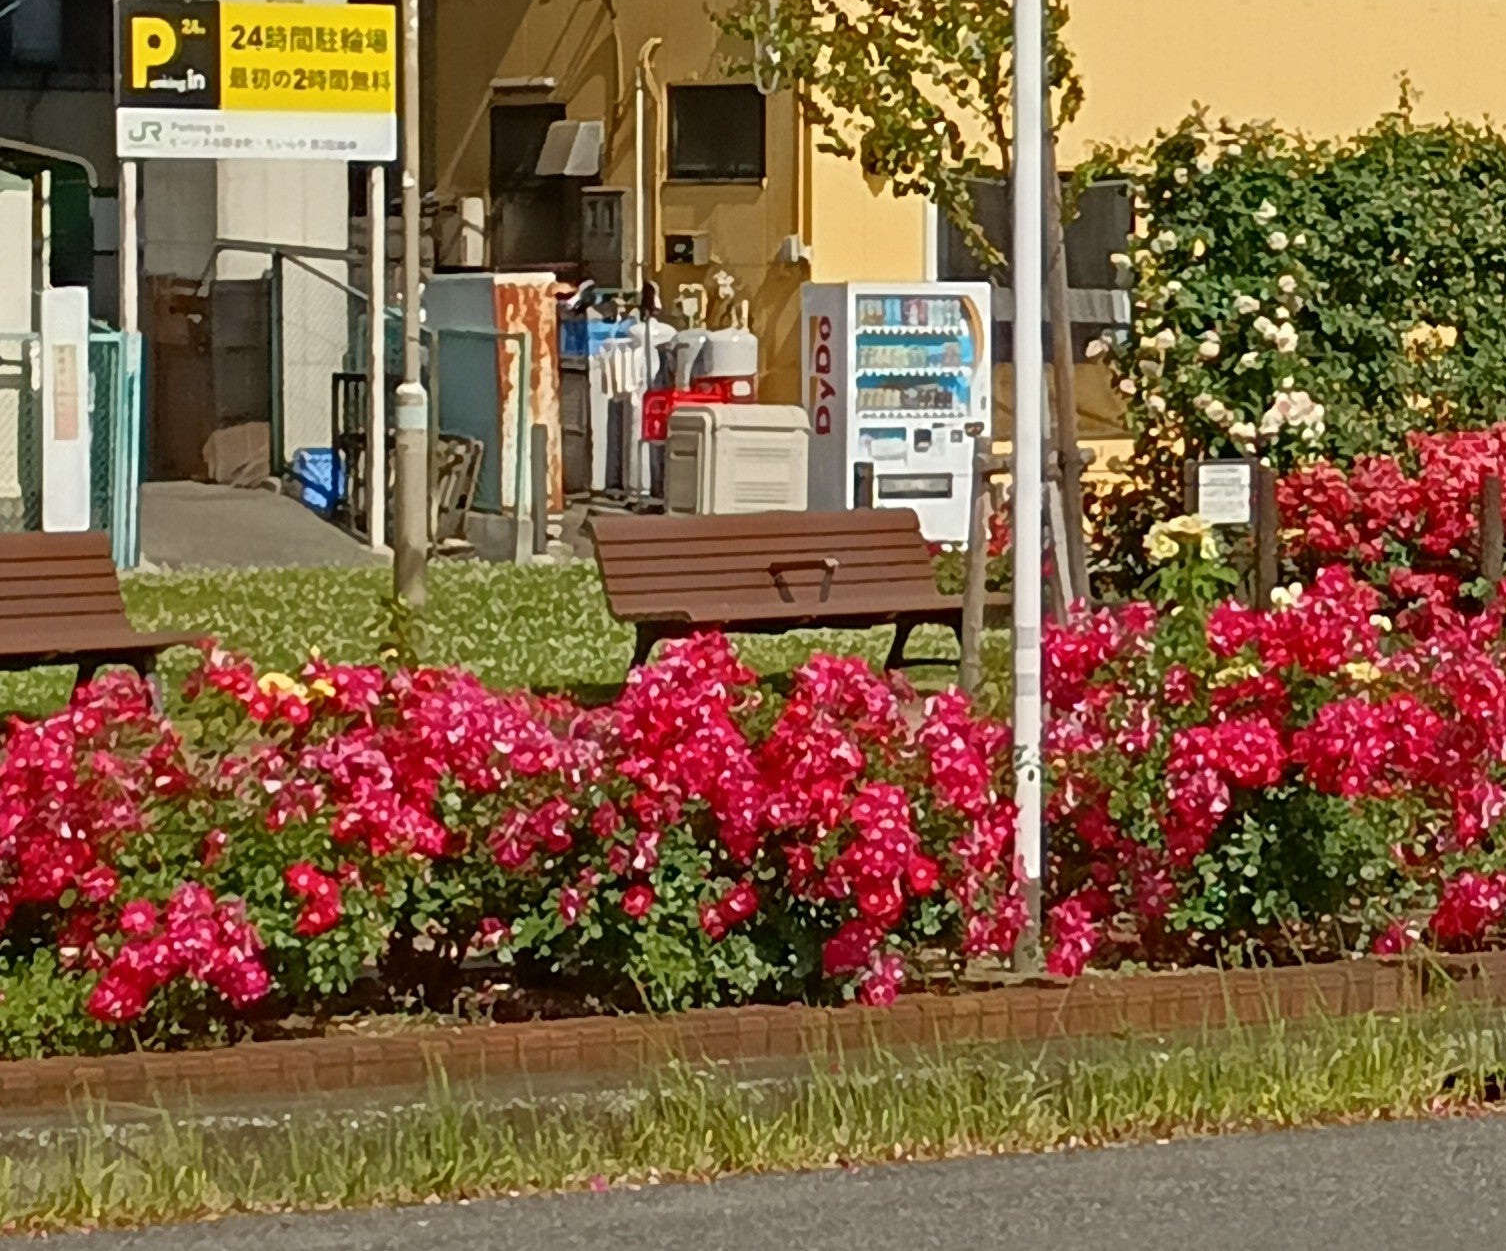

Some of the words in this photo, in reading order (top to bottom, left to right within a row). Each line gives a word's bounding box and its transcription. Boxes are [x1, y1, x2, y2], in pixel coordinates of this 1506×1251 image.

[229, 67, 392, 92] 最初の2時間無料
[128, 121, 162, 142] JR
